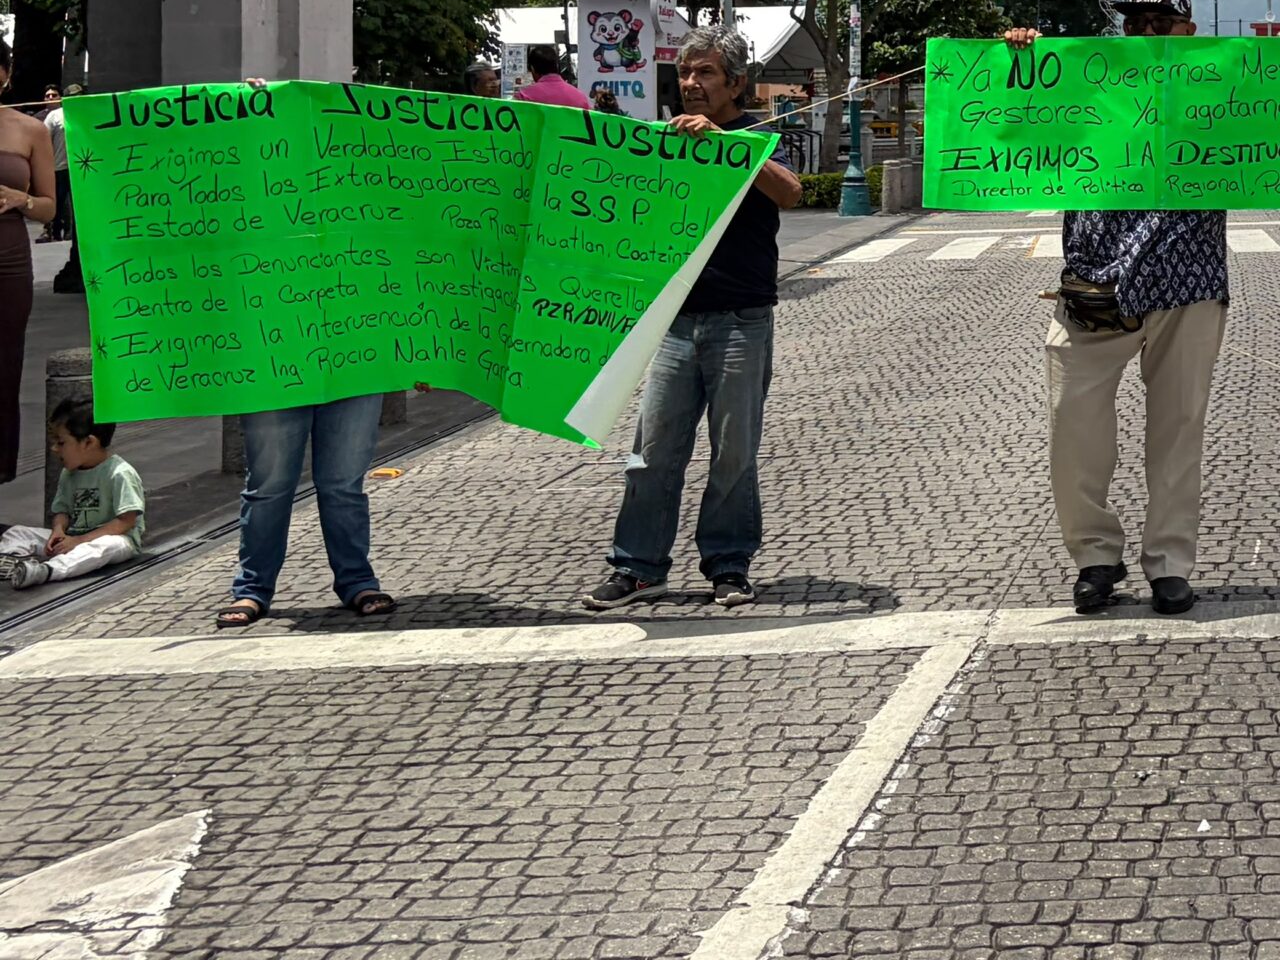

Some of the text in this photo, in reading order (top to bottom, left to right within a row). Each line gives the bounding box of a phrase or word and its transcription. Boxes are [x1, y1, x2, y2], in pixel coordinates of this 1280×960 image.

[955, 49, 992, 93] Ya
[1006, 46, 1062, 90] NO
[1083, 52, 1223, 94] Queremos
[95, 83, 751, 170] Justicia Justicia Justicia
[112, 123, 691, 201] Exigimos un Verdadero Estado de Derecho
[940, 145, 1100, 181] EXIGIMOS
[951, 177, 1031, 198] Director
[1042, 179, 1065, 196] de
[109, 212, 220, 240] Estado
[232, 210, 265, 232] de
[441, 204, 481, 230] Poza
[114, 183, 171, 209] Para
[179, 173, 246, 205] Todos
[263, 171, 299, 197] los
[306, 163, 501, 199] Extrabajadores
[513, 175, 531, 203] de
[543, 183, 561, 214] la
[670, 204, 711, 238] del
[106, 256, 178, 286] Todos
[192, 255, 223, 279] los
[230, 237, 392, 276] Denunciantes
[415, 250, 456, 268] son
[471, 246, 537, 292] Victims
[113, 288, 193, 319] Dentro
[202, 288, 228, 313] de
[242, 289, 262, 309] la
[278, 271, 360, 307] Carpeta
[378, 272, 401, 296] de
[111, 331, 242, 368] Exigimos
[259, 322, 283, 346] la
[449, 307, 471, 332] de
[478, 311, 491, 340] la
[126, 369, 153, 393] de
[159, 362, 256, 391] Veracruz
[395, 335, 467, 364] Nahle
